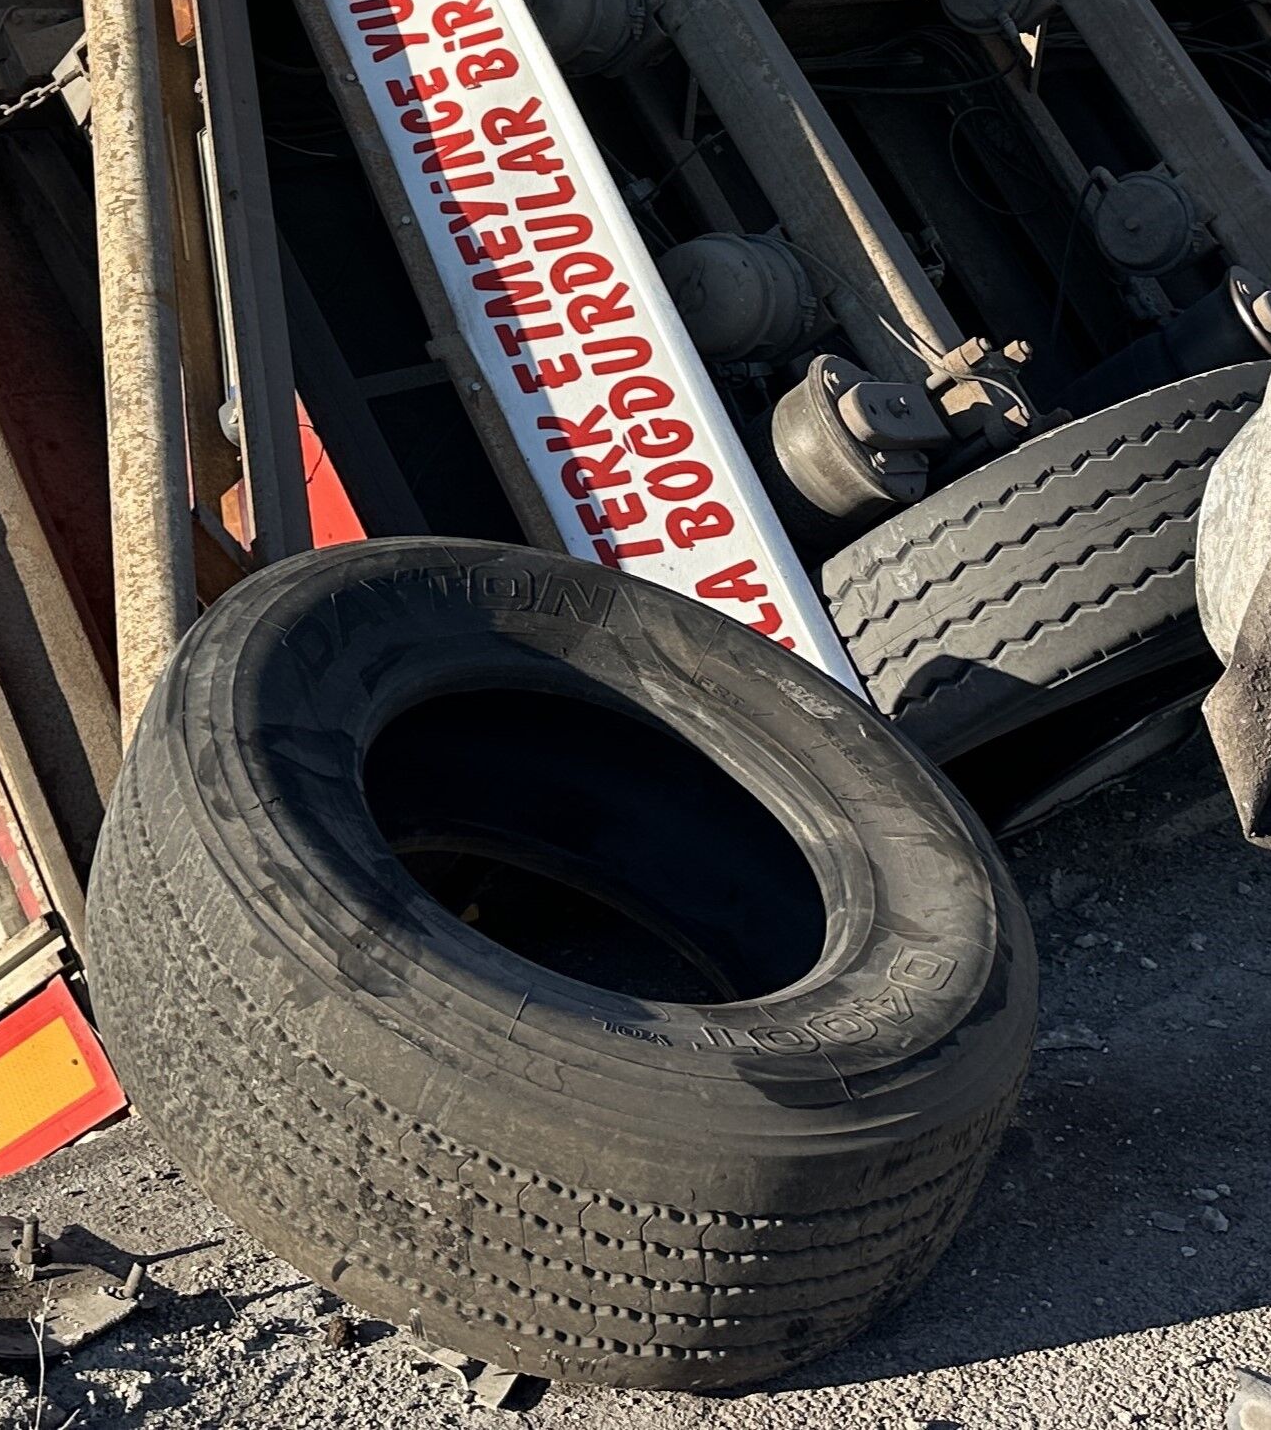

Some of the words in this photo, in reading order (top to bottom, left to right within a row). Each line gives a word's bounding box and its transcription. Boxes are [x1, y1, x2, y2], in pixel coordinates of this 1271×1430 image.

[385, 65, 583, 394] ETMEYİNCE
[536, 404, 665, 569] TERK
[282, 562, 617, 678] DAYTON
[695, 558, 797, 651] LA
